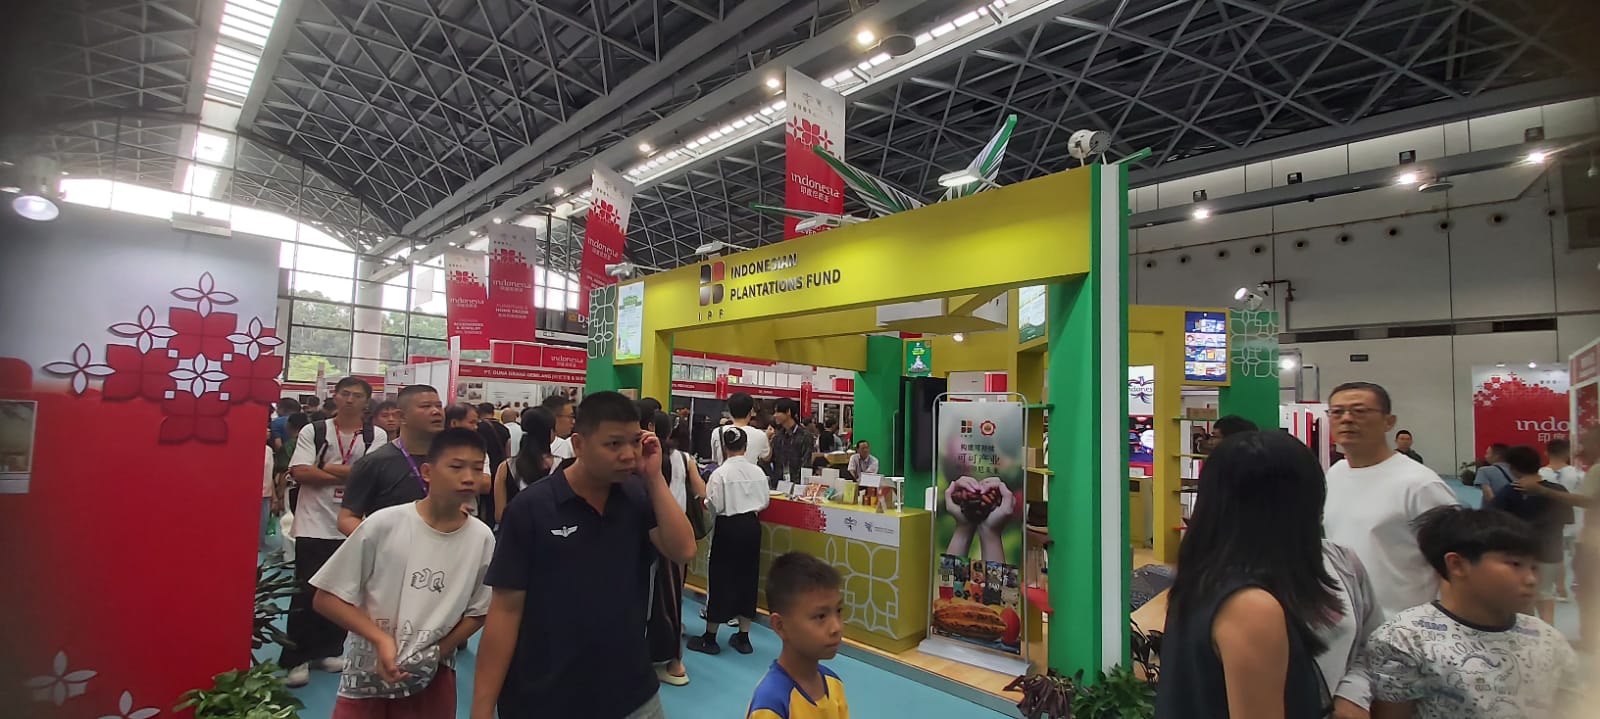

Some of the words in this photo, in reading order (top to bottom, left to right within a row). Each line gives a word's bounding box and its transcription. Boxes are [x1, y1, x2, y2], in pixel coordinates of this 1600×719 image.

[791, 172, 841, 198] indonesia
[731, 252, 797, 279] INDONESIAN
[730, 276, 803, 301] PLANTATIONS
[806, 269, 841, 288] FUND
